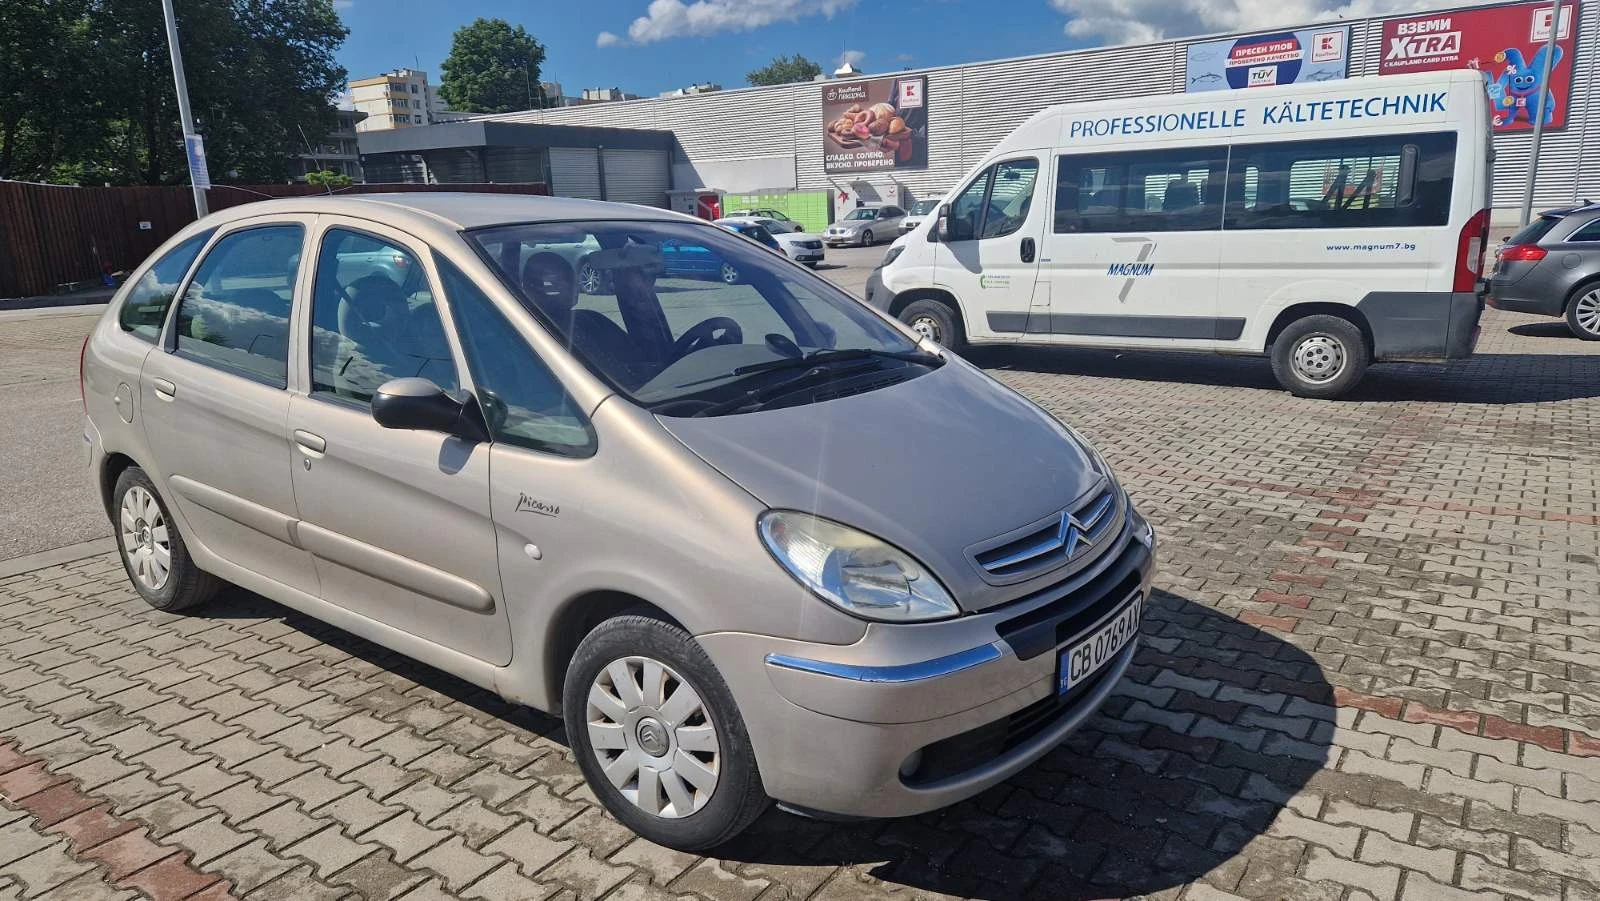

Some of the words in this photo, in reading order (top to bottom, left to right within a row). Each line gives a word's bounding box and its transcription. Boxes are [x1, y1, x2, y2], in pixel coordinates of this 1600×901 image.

[1398, 18, 1451, 35] ВЗЕМИ
[1235, 47, 1267, 57] ПРЕСЕН
[1269, 42, 1293, 52] УЛОВ
[1384, 32, 1461, 60] XTRA
[1229, 57, 1266, 65] ПРОВЕРЕНО
[1266, 52, 1300, 61] КАЧЕСТВО
[1389, 58, 1423, 67] KAUFLAND
[1070, 109, 1246, 138] PROFESSIONELLE
[1263, 92, 1447, 124] KÄLTETECHNIK
[1326, 242, 1416, 251] www.magnum7.bg
[1107, 263, 1155, 276] MAGNUM
[514, 491, 560, 515] Picasso
[1070, 643, 1091, 682] CB
[1094, 617, 1125, 664] 0769
